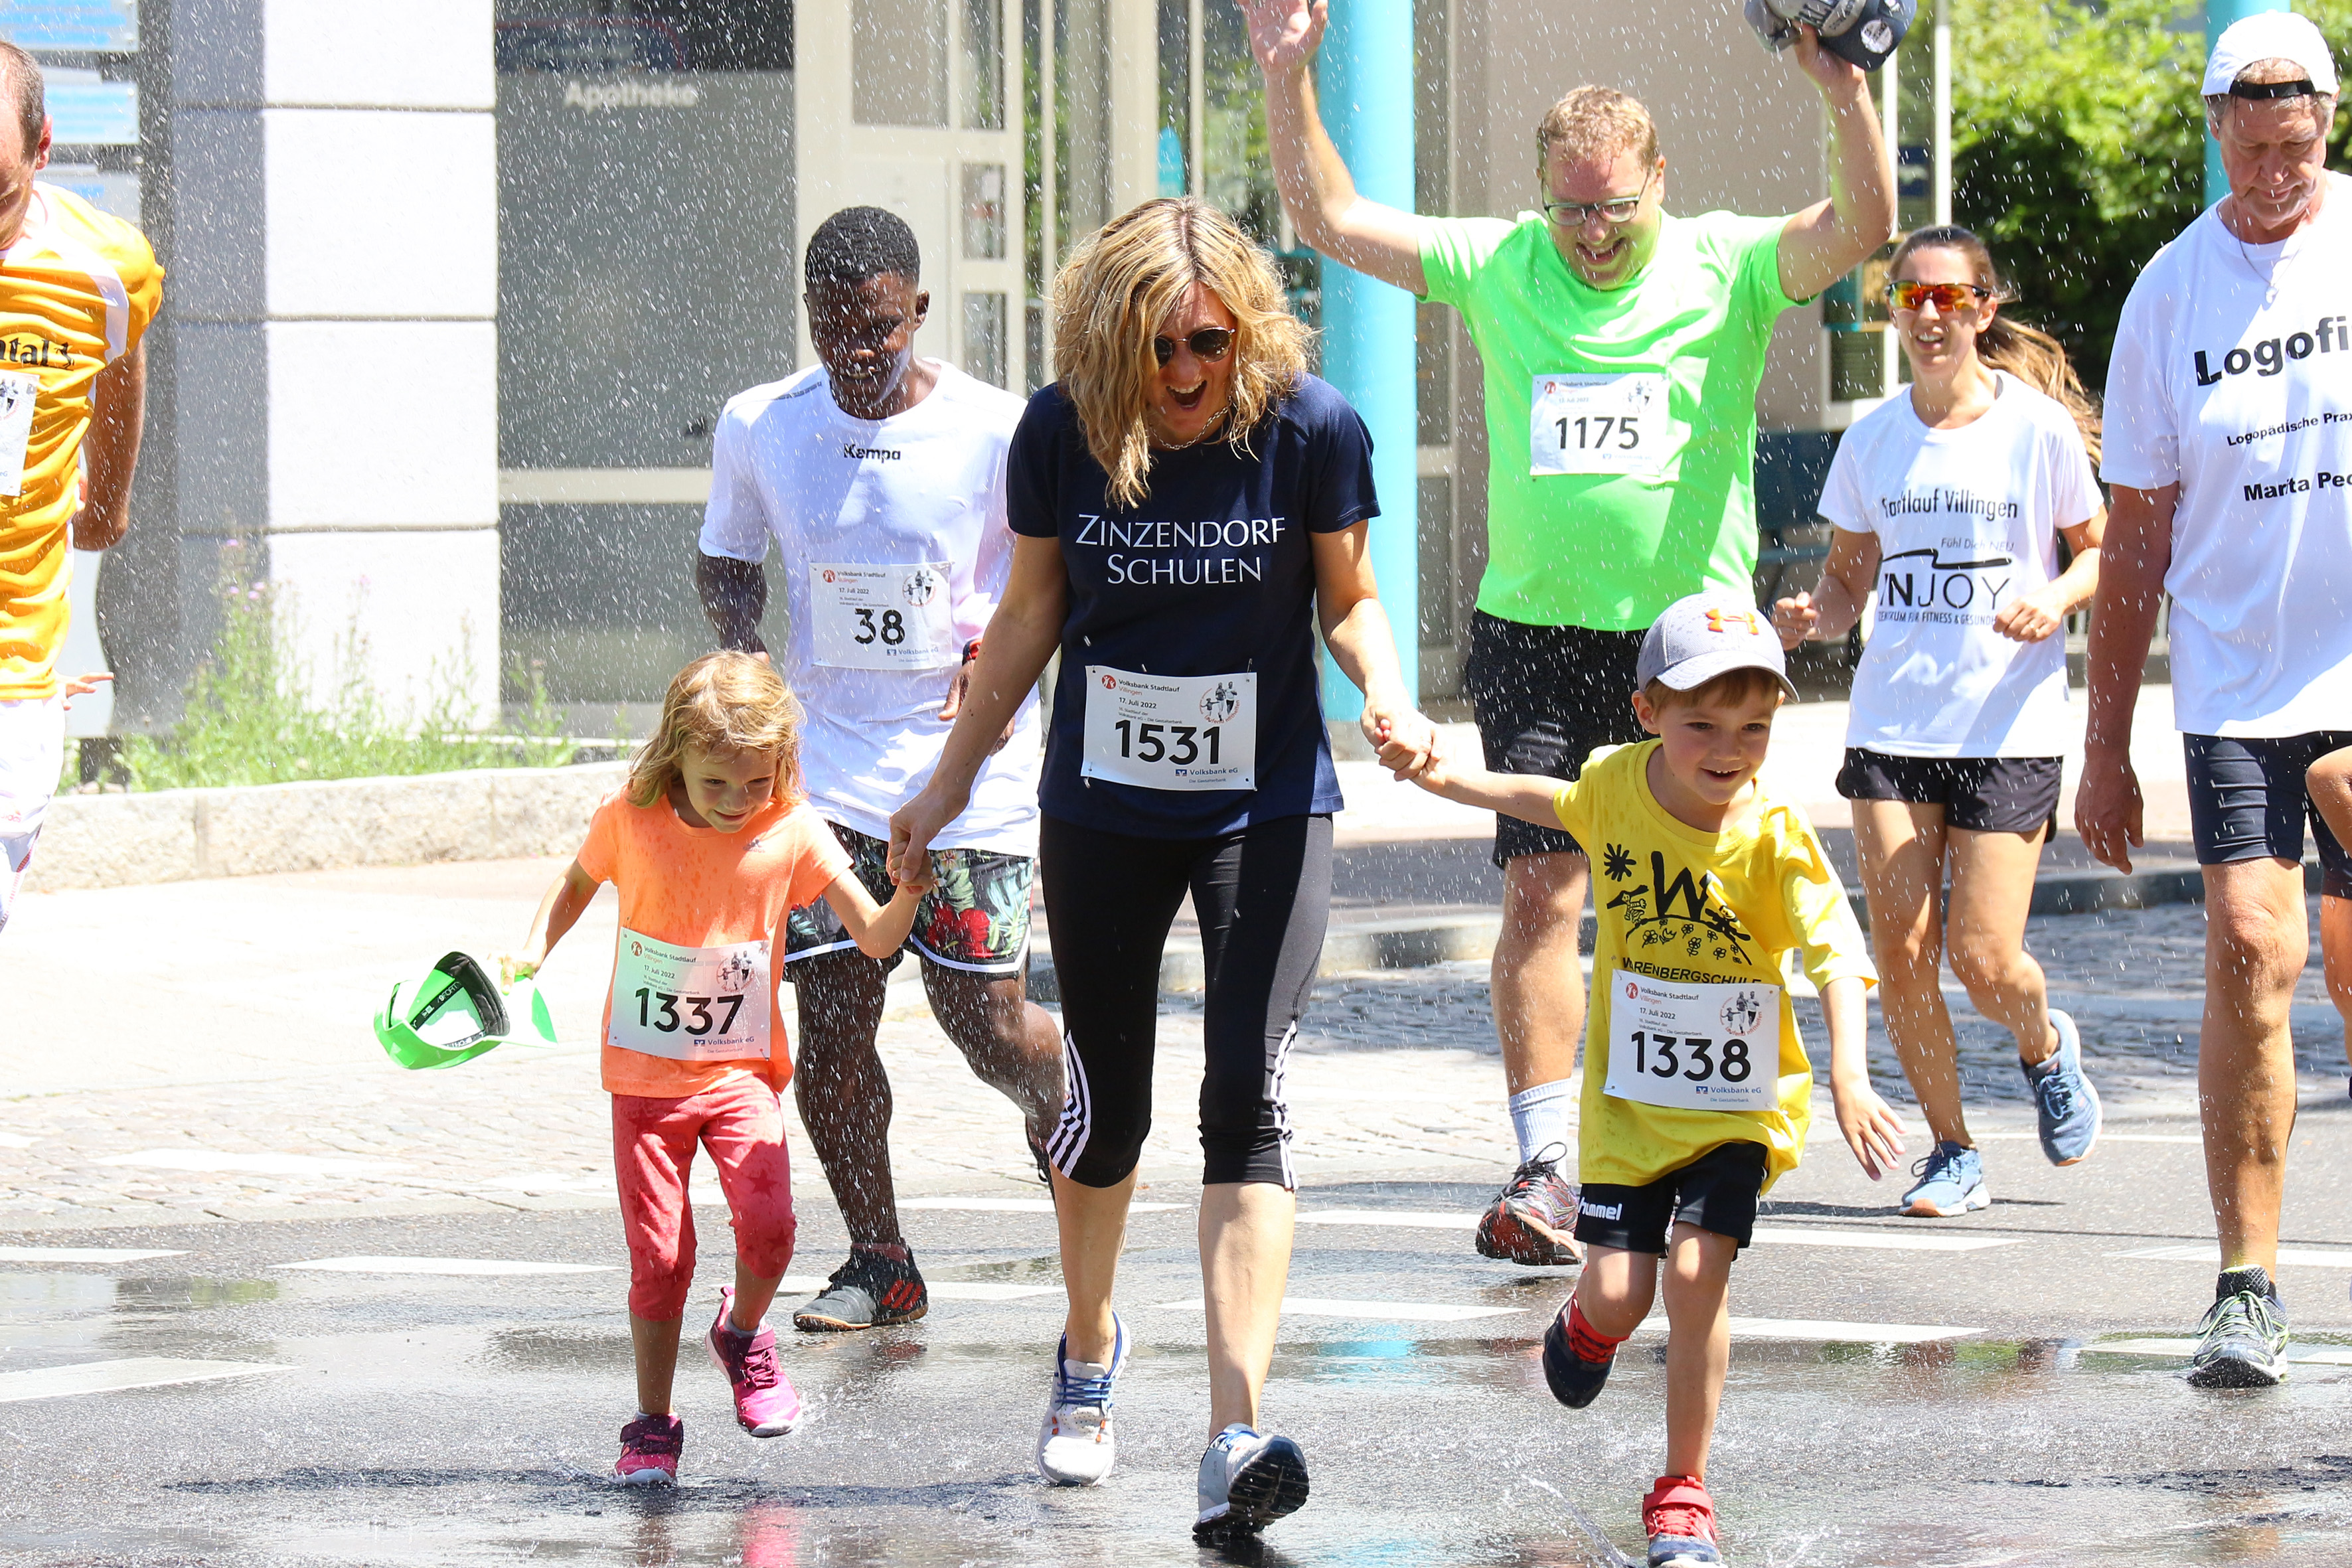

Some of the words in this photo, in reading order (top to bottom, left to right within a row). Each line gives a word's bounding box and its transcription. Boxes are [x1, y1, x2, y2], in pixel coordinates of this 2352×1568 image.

[564, 80, 698, 114] Apotheke
[2194, 315, 2352, 386] Logofi
[1555, 416, 1639, 449] 1175
[2227, 416, 2319, 446] Logopädische
[843, 443, 901, 463] Kempa
[1945, 489, 2018, 522] Villingen
[1075, 513, 1285, 548] ZINZENDORF
[1964, 537, 1985, 549] Dich
[1990, 540, 2015, 552] NEU
[1107, 554, 1261, 585] SCHULEN
[854, 608, 905, 645] 38
[1922, 611, 1952, 624] FITNESS
[1119, 678, 1149, 690] Volksbank
[1119, 686, 1142, 696] Villingen
[1115, 719, 1221, 765] 1531
[644, 945, 668, 959] Volksbank
[669, 954, 696, 963] Stadtlauf
[644, 953, 663, 965] Villingen
[661, 971, 675, 979] 2022
[1640, 986, 1668, 998] Volksbank
[1640, 994, 1662, 1005] Villingen
[635, 987, 744, 1036] 1337
[1660, 1011, 1676, 1020] 2022
[708, 1037, 744, 1046] Volksbank
[1631, 1030, 1751, 1083] 1338
[1577, 1196, 1622, 1221] hummel
